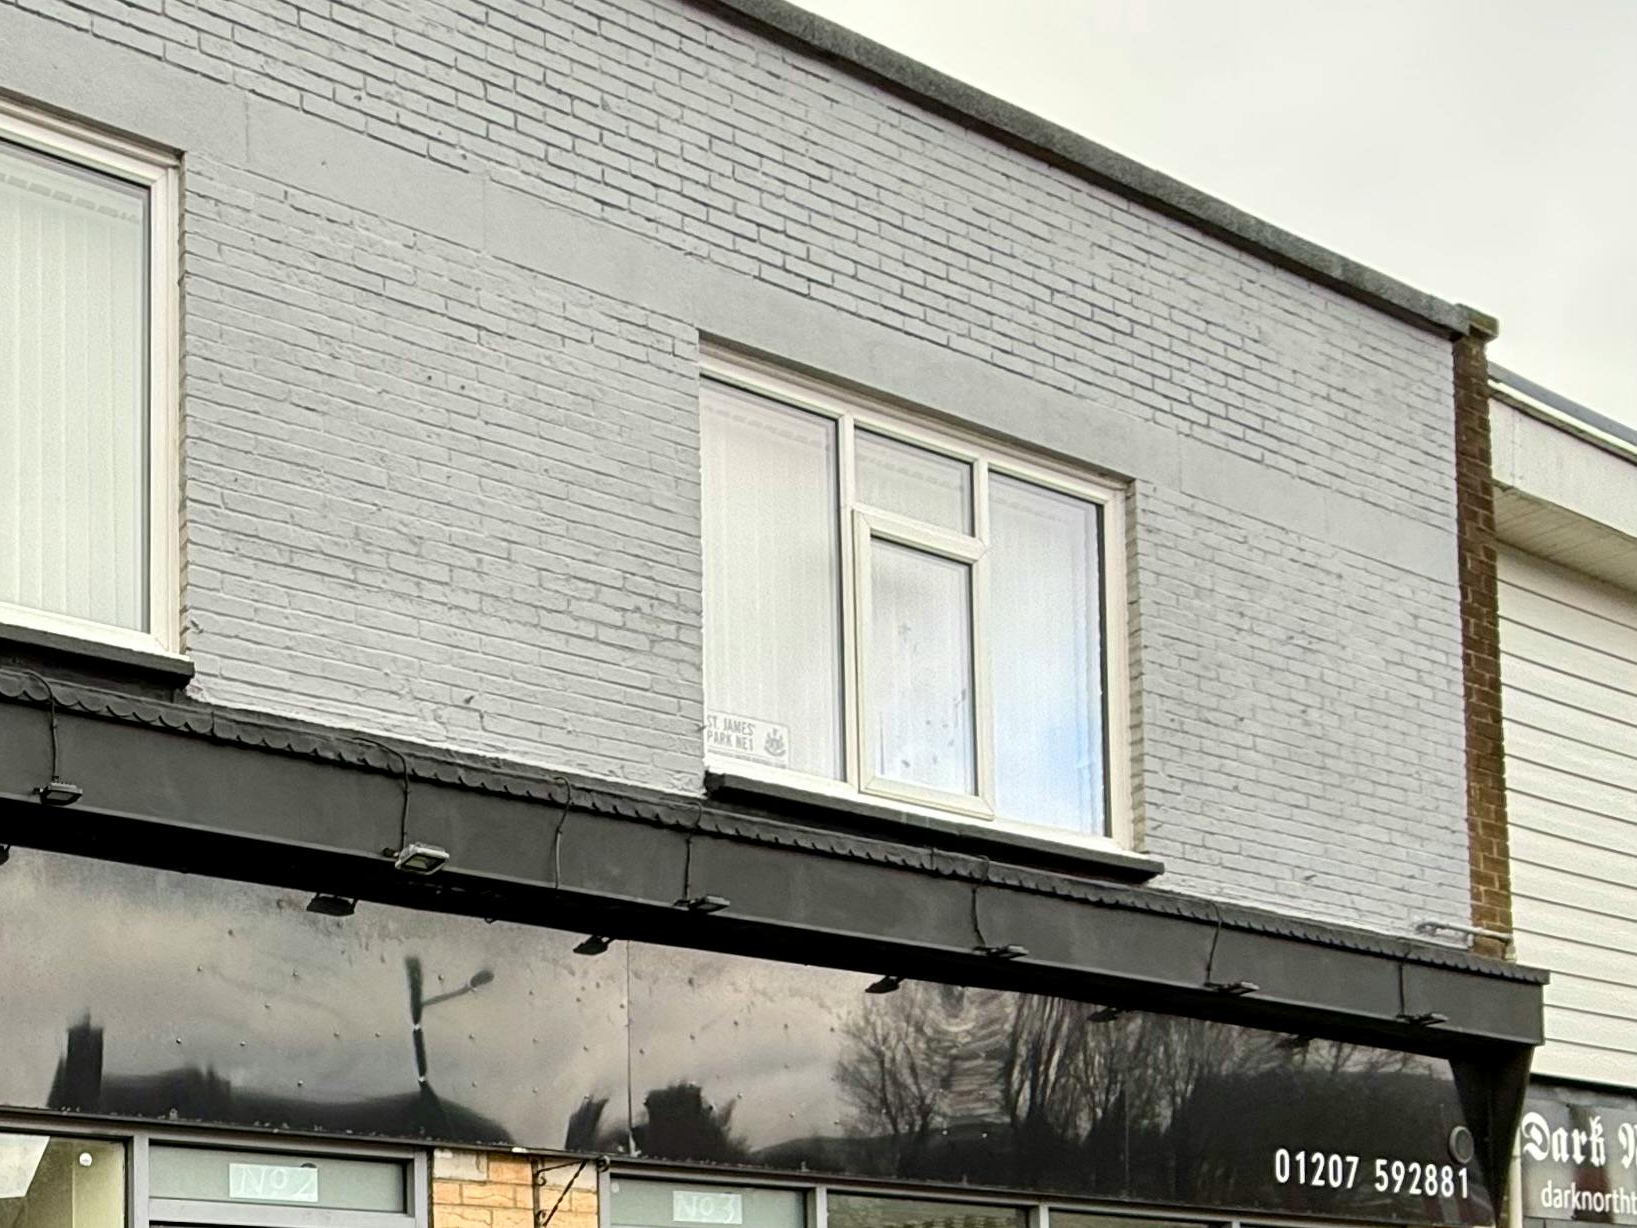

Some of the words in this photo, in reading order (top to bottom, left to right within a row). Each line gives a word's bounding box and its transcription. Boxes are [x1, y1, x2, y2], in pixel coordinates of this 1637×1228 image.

[707, 730, 732, 747] PARK
[1522, 1111, 1606, 1167] Dark
[1274, 1148, 1360, 1189] 01207
[1374, 1158, 1469, 1199] 592881
